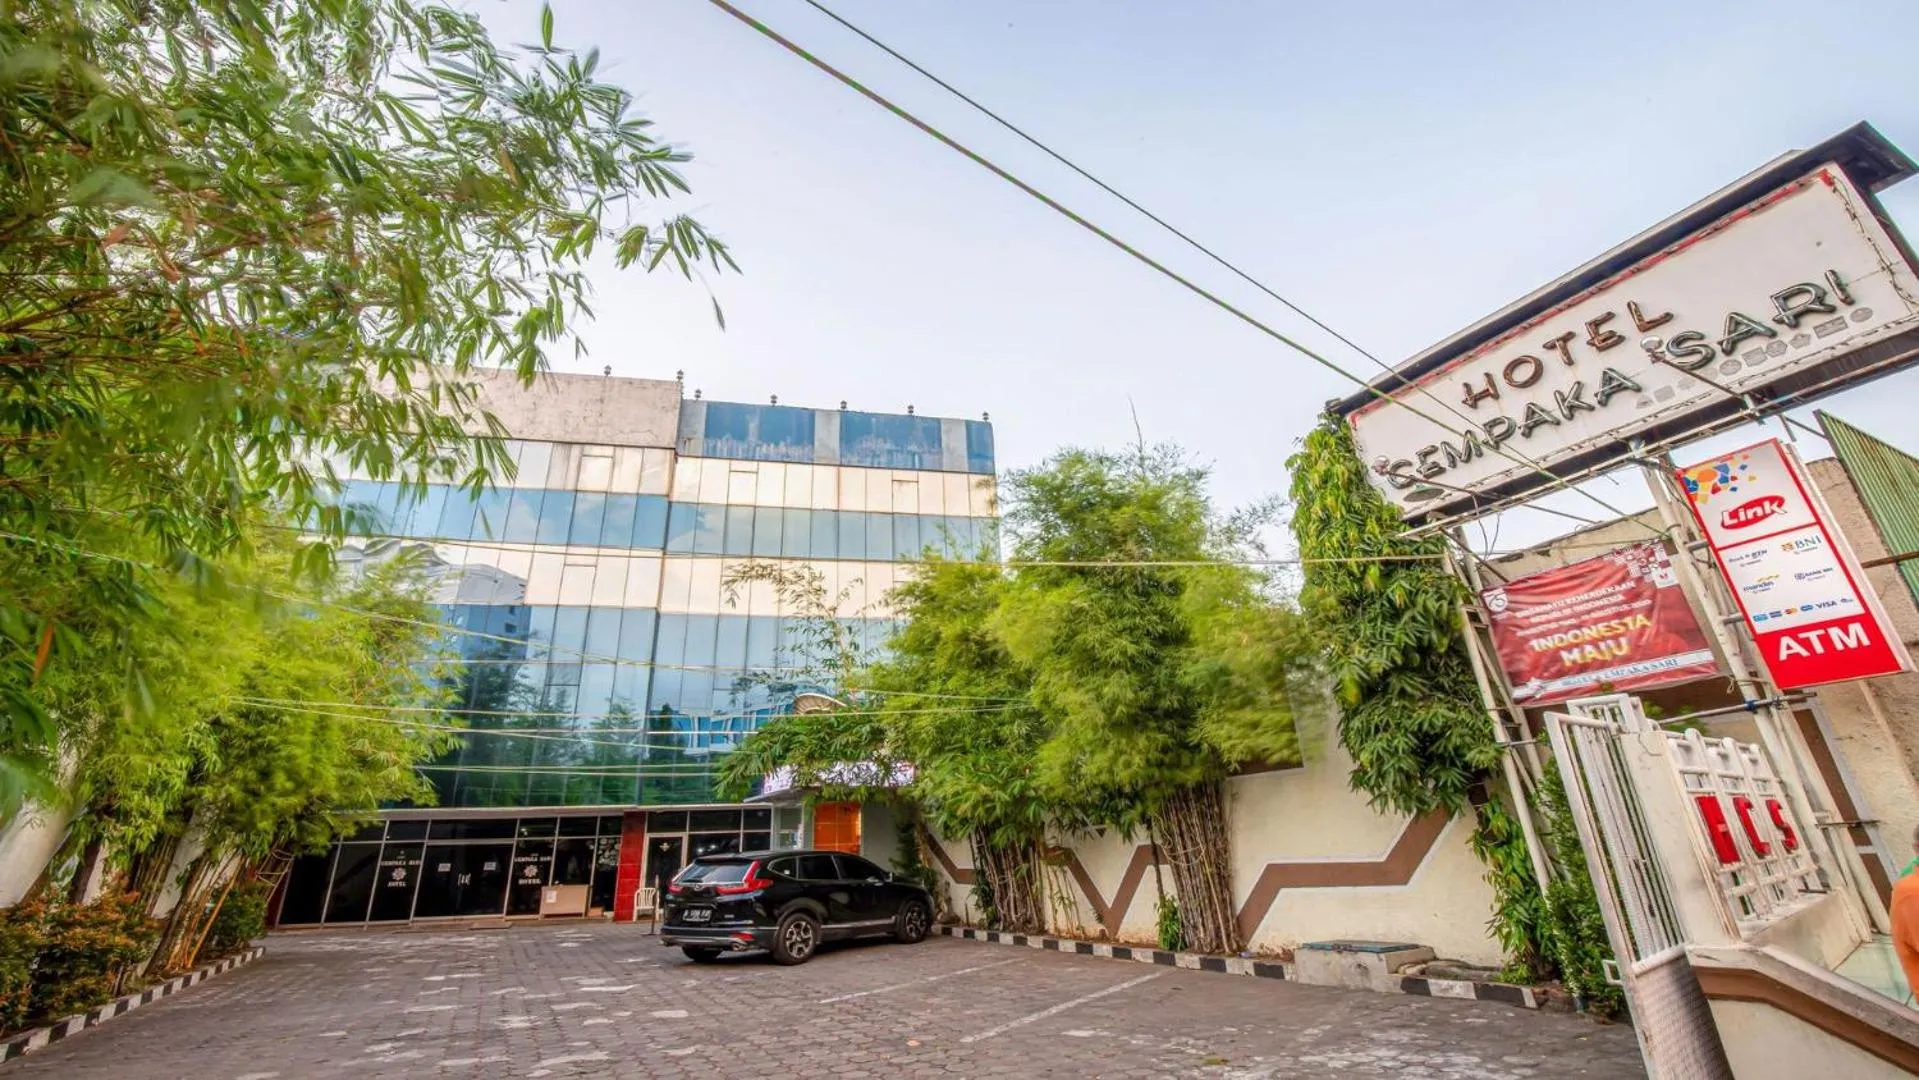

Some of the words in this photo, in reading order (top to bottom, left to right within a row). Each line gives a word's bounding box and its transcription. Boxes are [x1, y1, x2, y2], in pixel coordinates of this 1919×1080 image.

[1461, 300, 1674, 409] HOTEL
[1386, 367, 1643, 489] CEMPAKA
[1665, 269, 1856, 371] SARI
[1721, 498, 1788, 527] Link
[1795, 534, 1822, 549] BNI
[1815, 600, 1837, 609] VISA
[1528, 613, 1651, 652] INDONESIA
[1778, 621, 1872, 662] ATM
[1559, 637, 1631, 667] MAJU
[1650, 658, 1679, 670] SARI
